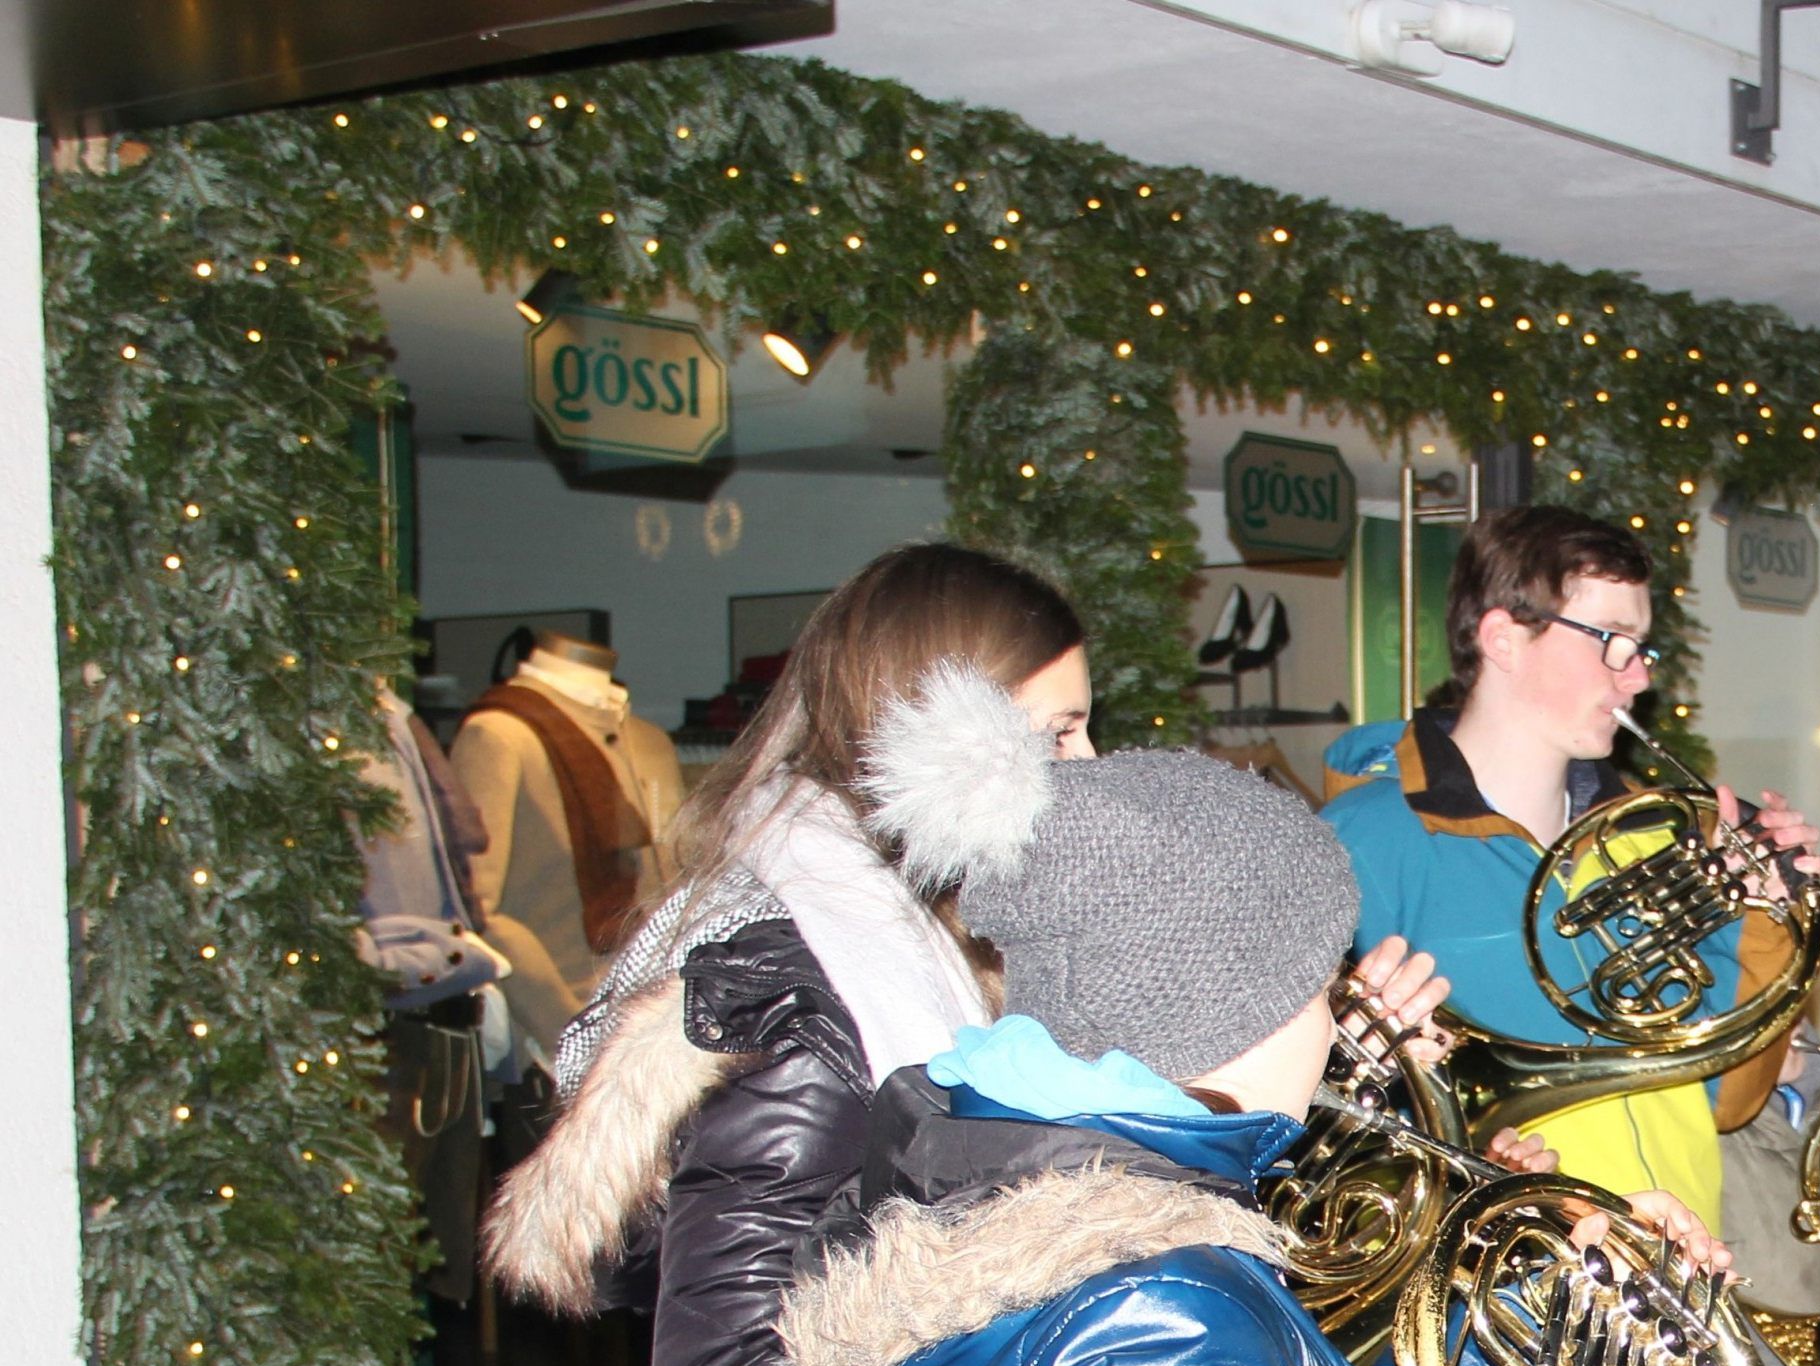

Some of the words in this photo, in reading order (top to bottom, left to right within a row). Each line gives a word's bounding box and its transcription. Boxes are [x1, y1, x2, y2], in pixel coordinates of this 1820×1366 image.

[552, 338, 699, 423] gössl
[1241, 460, 1339, 529] gössl
[1738, 527, 1807, 585] gössl
